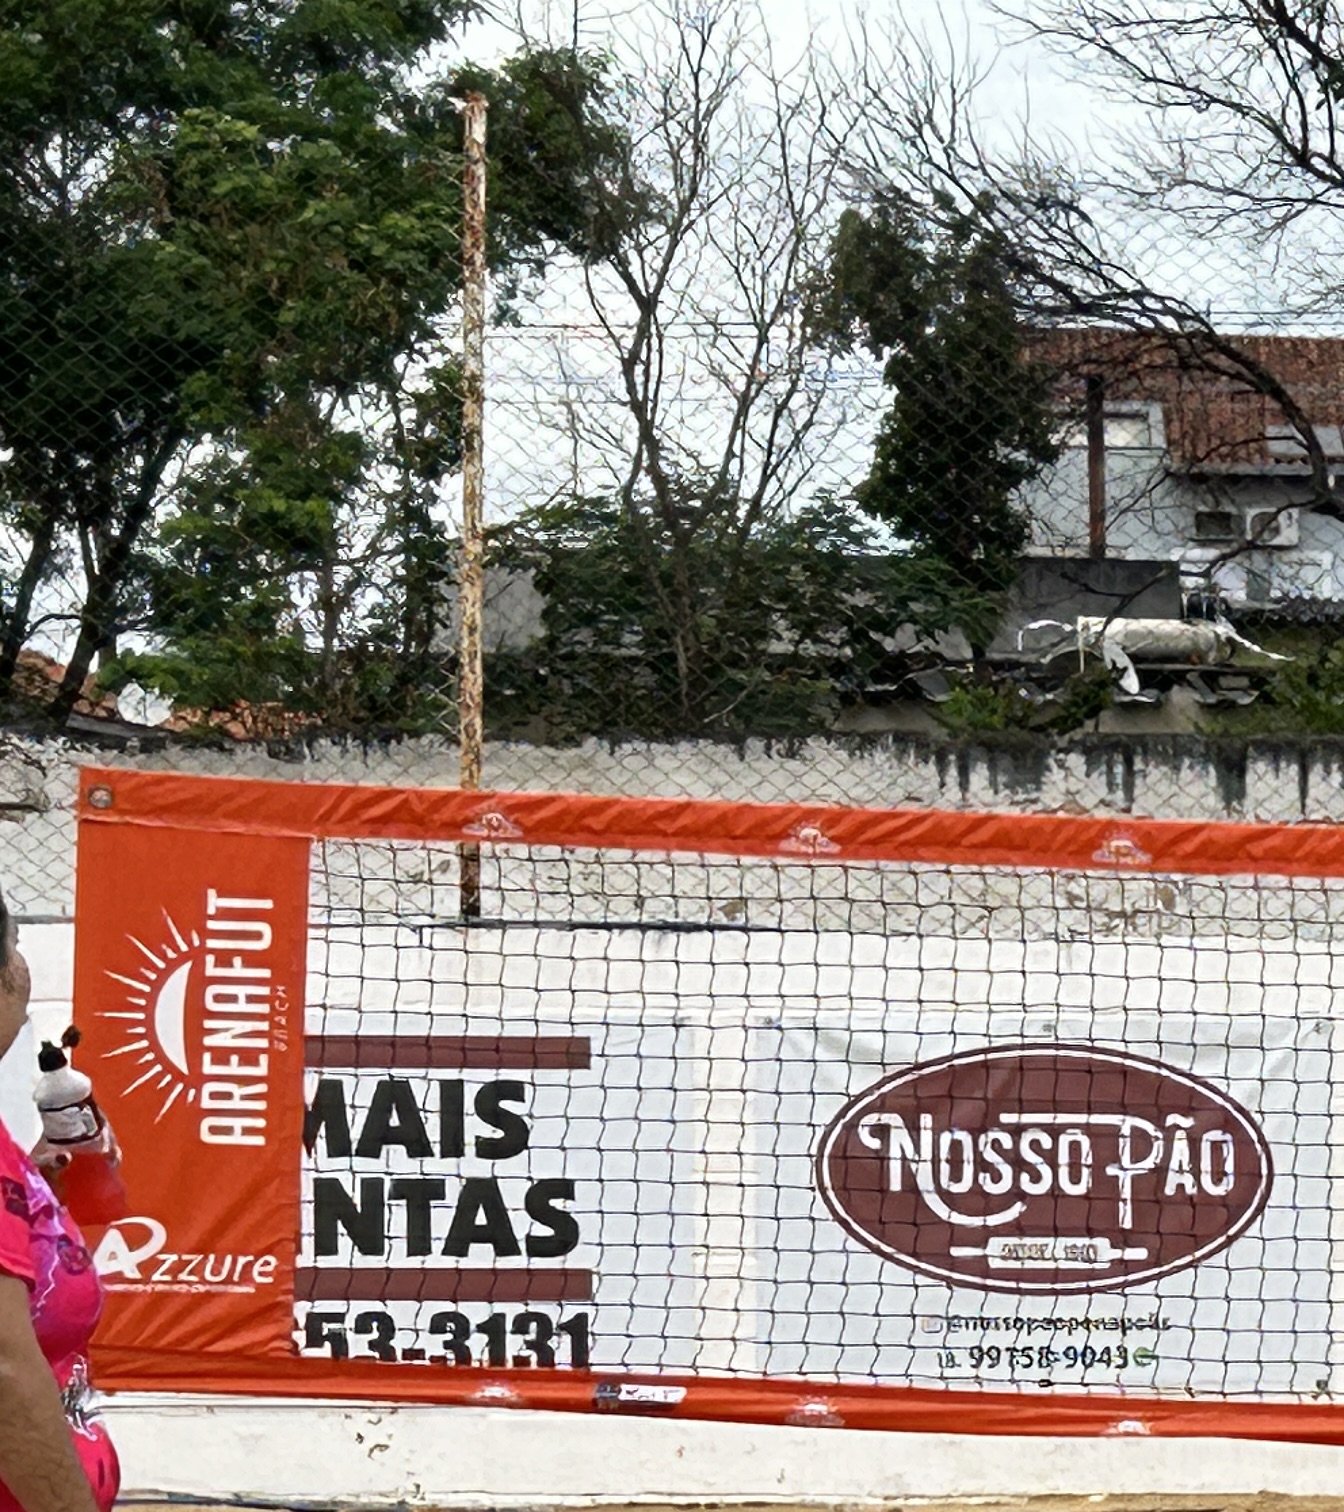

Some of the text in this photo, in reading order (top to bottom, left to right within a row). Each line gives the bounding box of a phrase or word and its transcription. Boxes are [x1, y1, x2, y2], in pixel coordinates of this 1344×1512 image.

[200, 888, 274, 1147] ARENAFUT
[312, 1176, 581, 1258] NTAS
[304, 1310, 590, 1369] 53-3131
